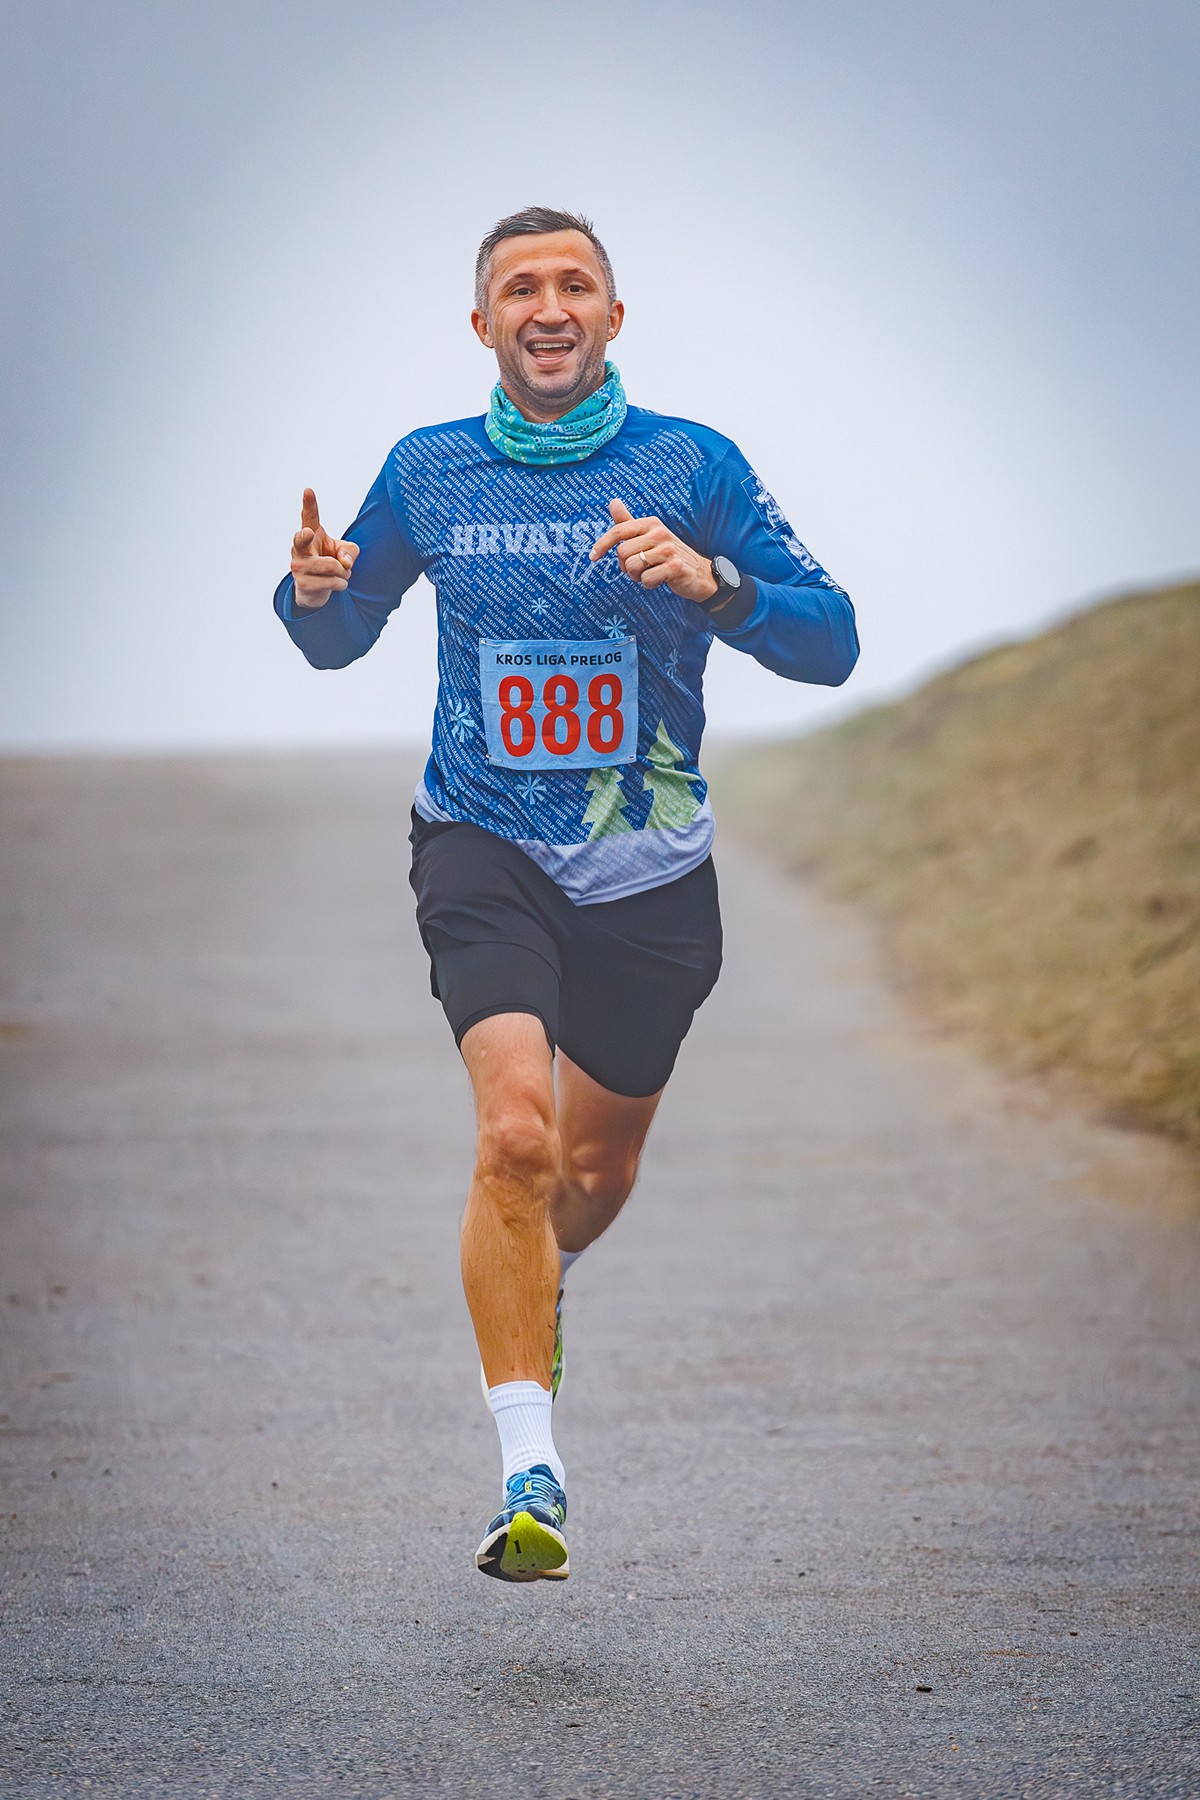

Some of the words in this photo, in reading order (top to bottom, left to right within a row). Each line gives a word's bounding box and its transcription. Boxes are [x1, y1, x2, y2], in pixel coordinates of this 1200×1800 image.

[505, 466, 534, 496] ALEKSANDAR
[611, 470, 637, 496] VALENTINA
[496, 653, 532, 666] KROS
[536, 654, 567, 666] LIGA
[570, 651, 622, 666] PRELOG
[498, 673, 625, 757] 888
